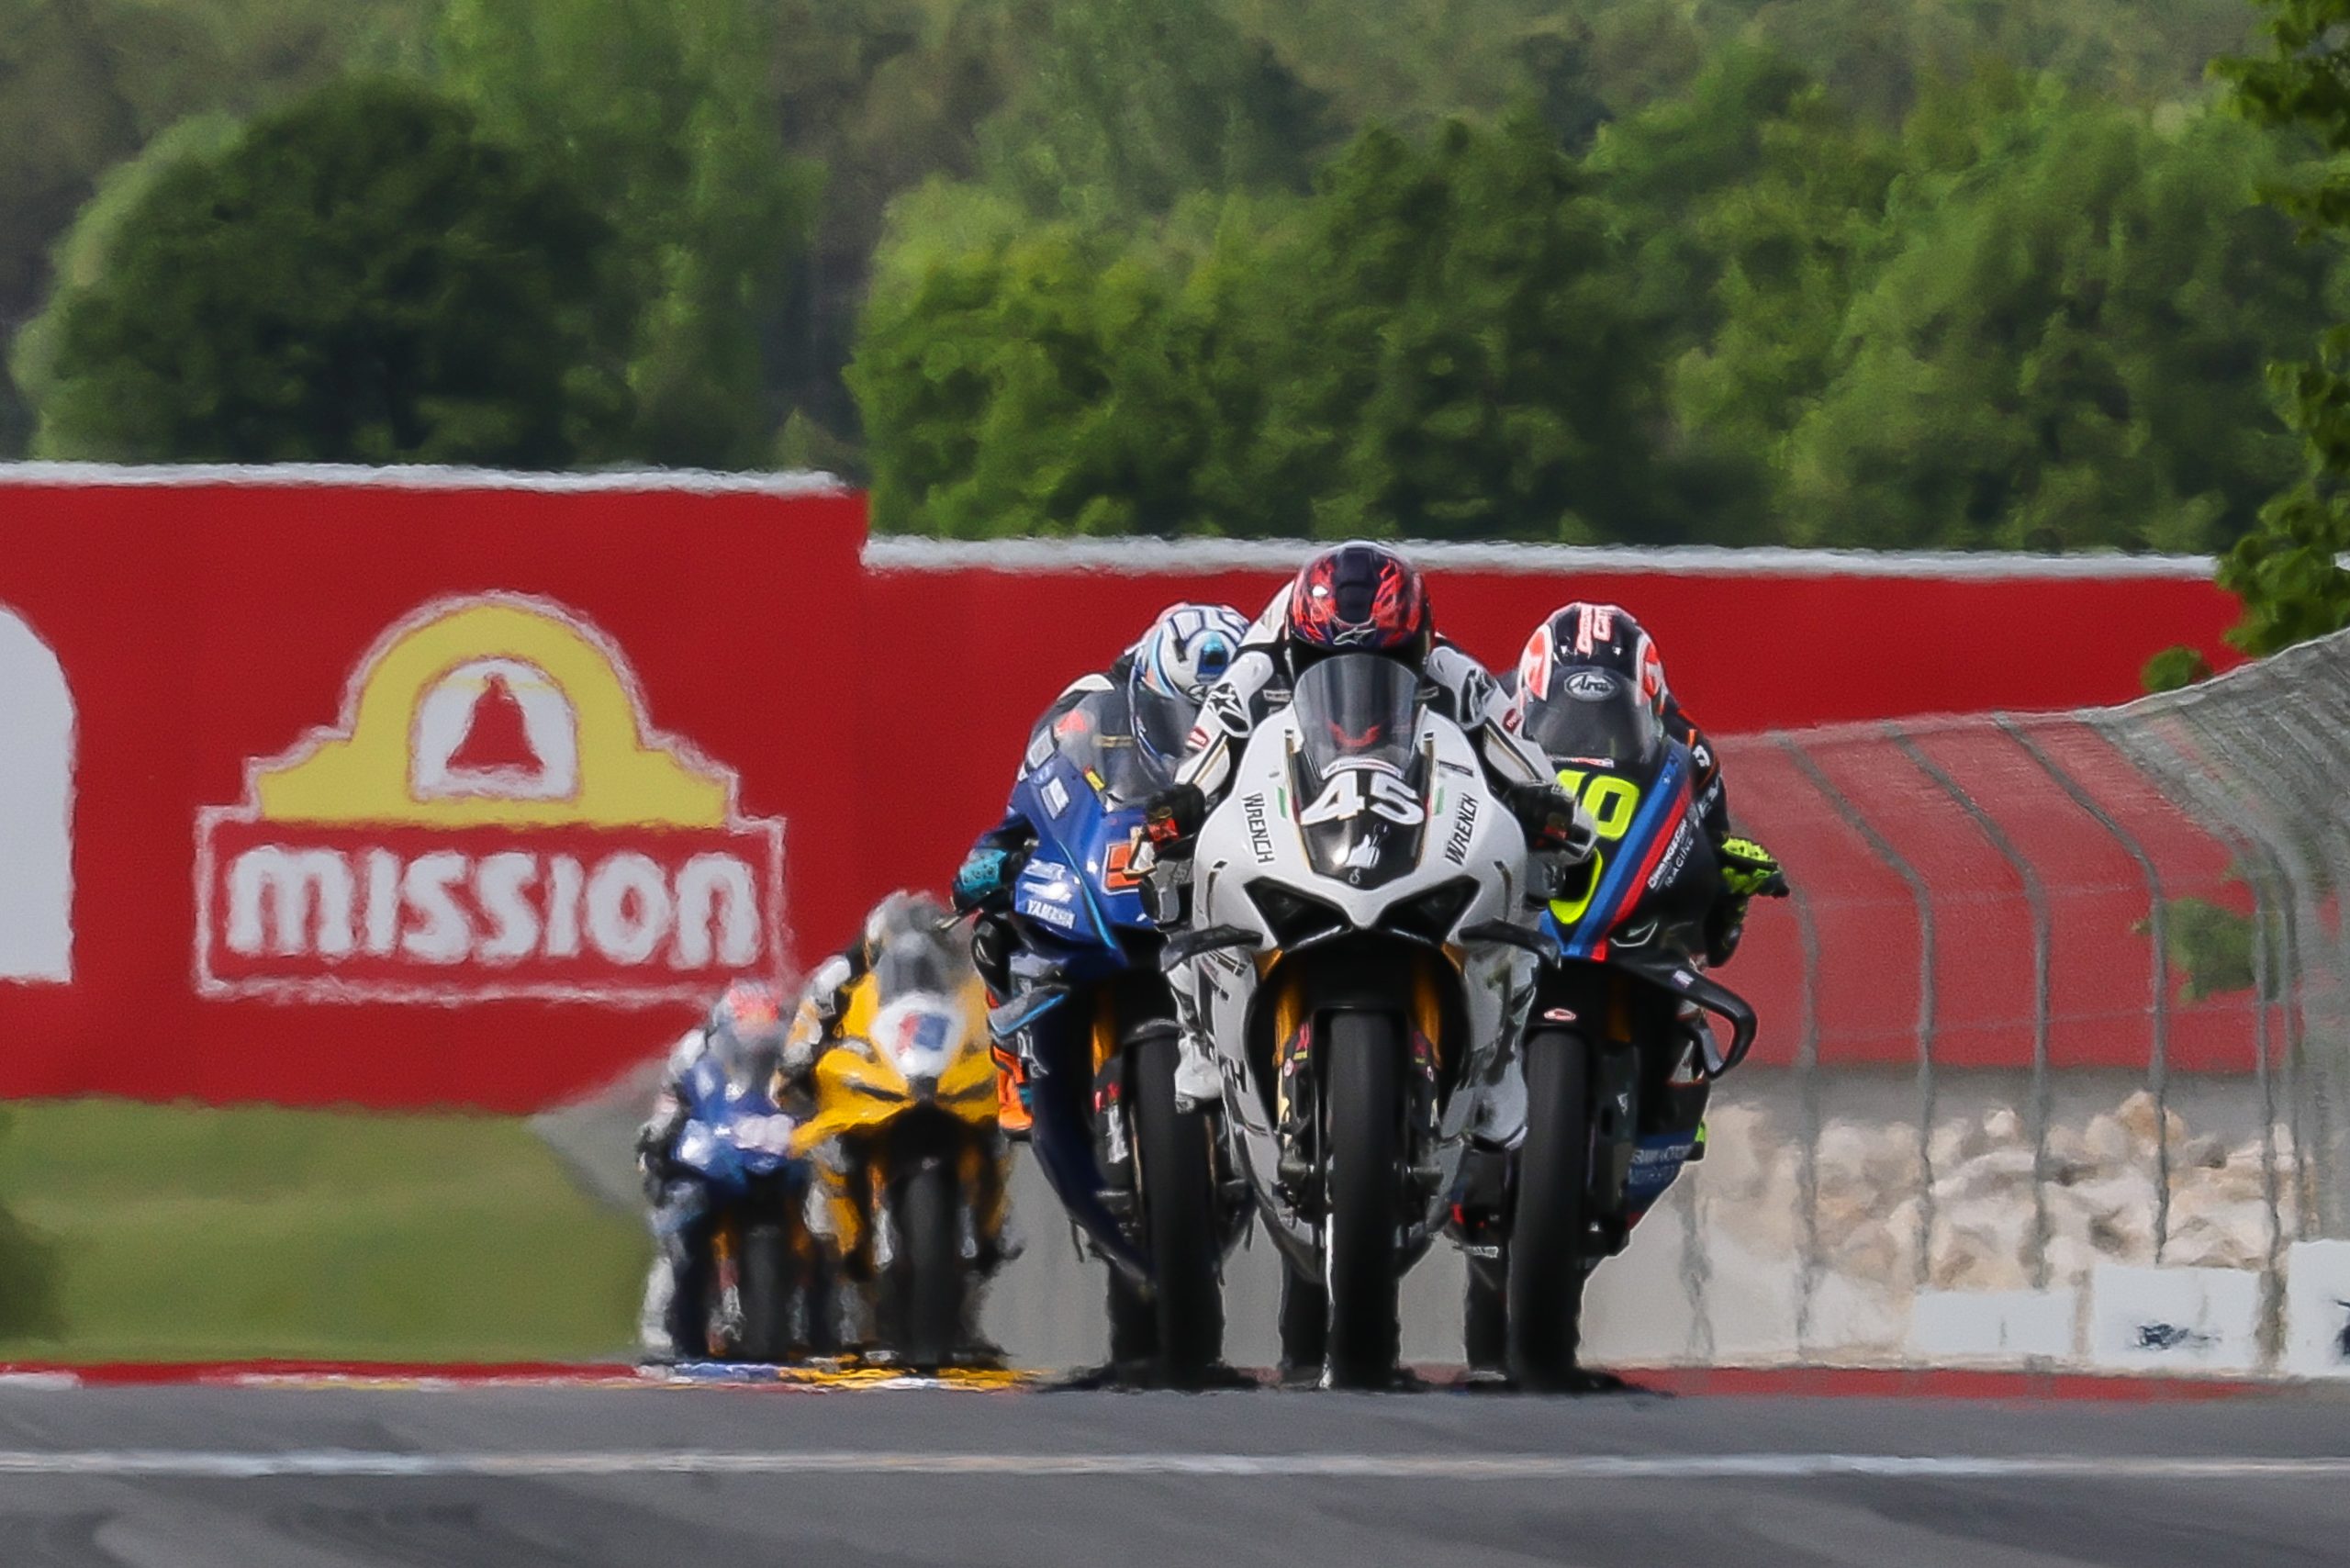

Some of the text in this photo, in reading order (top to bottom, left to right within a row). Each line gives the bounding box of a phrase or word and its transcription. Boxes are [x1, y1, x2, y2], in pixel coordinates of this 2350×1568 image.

[1241, 791, 1276, 864] WRENCH
[1300, 770, 1424, 825] 45
[1444, 791, 1479, 867] WRENCH
[226, 845, 759, 970] MISSION
